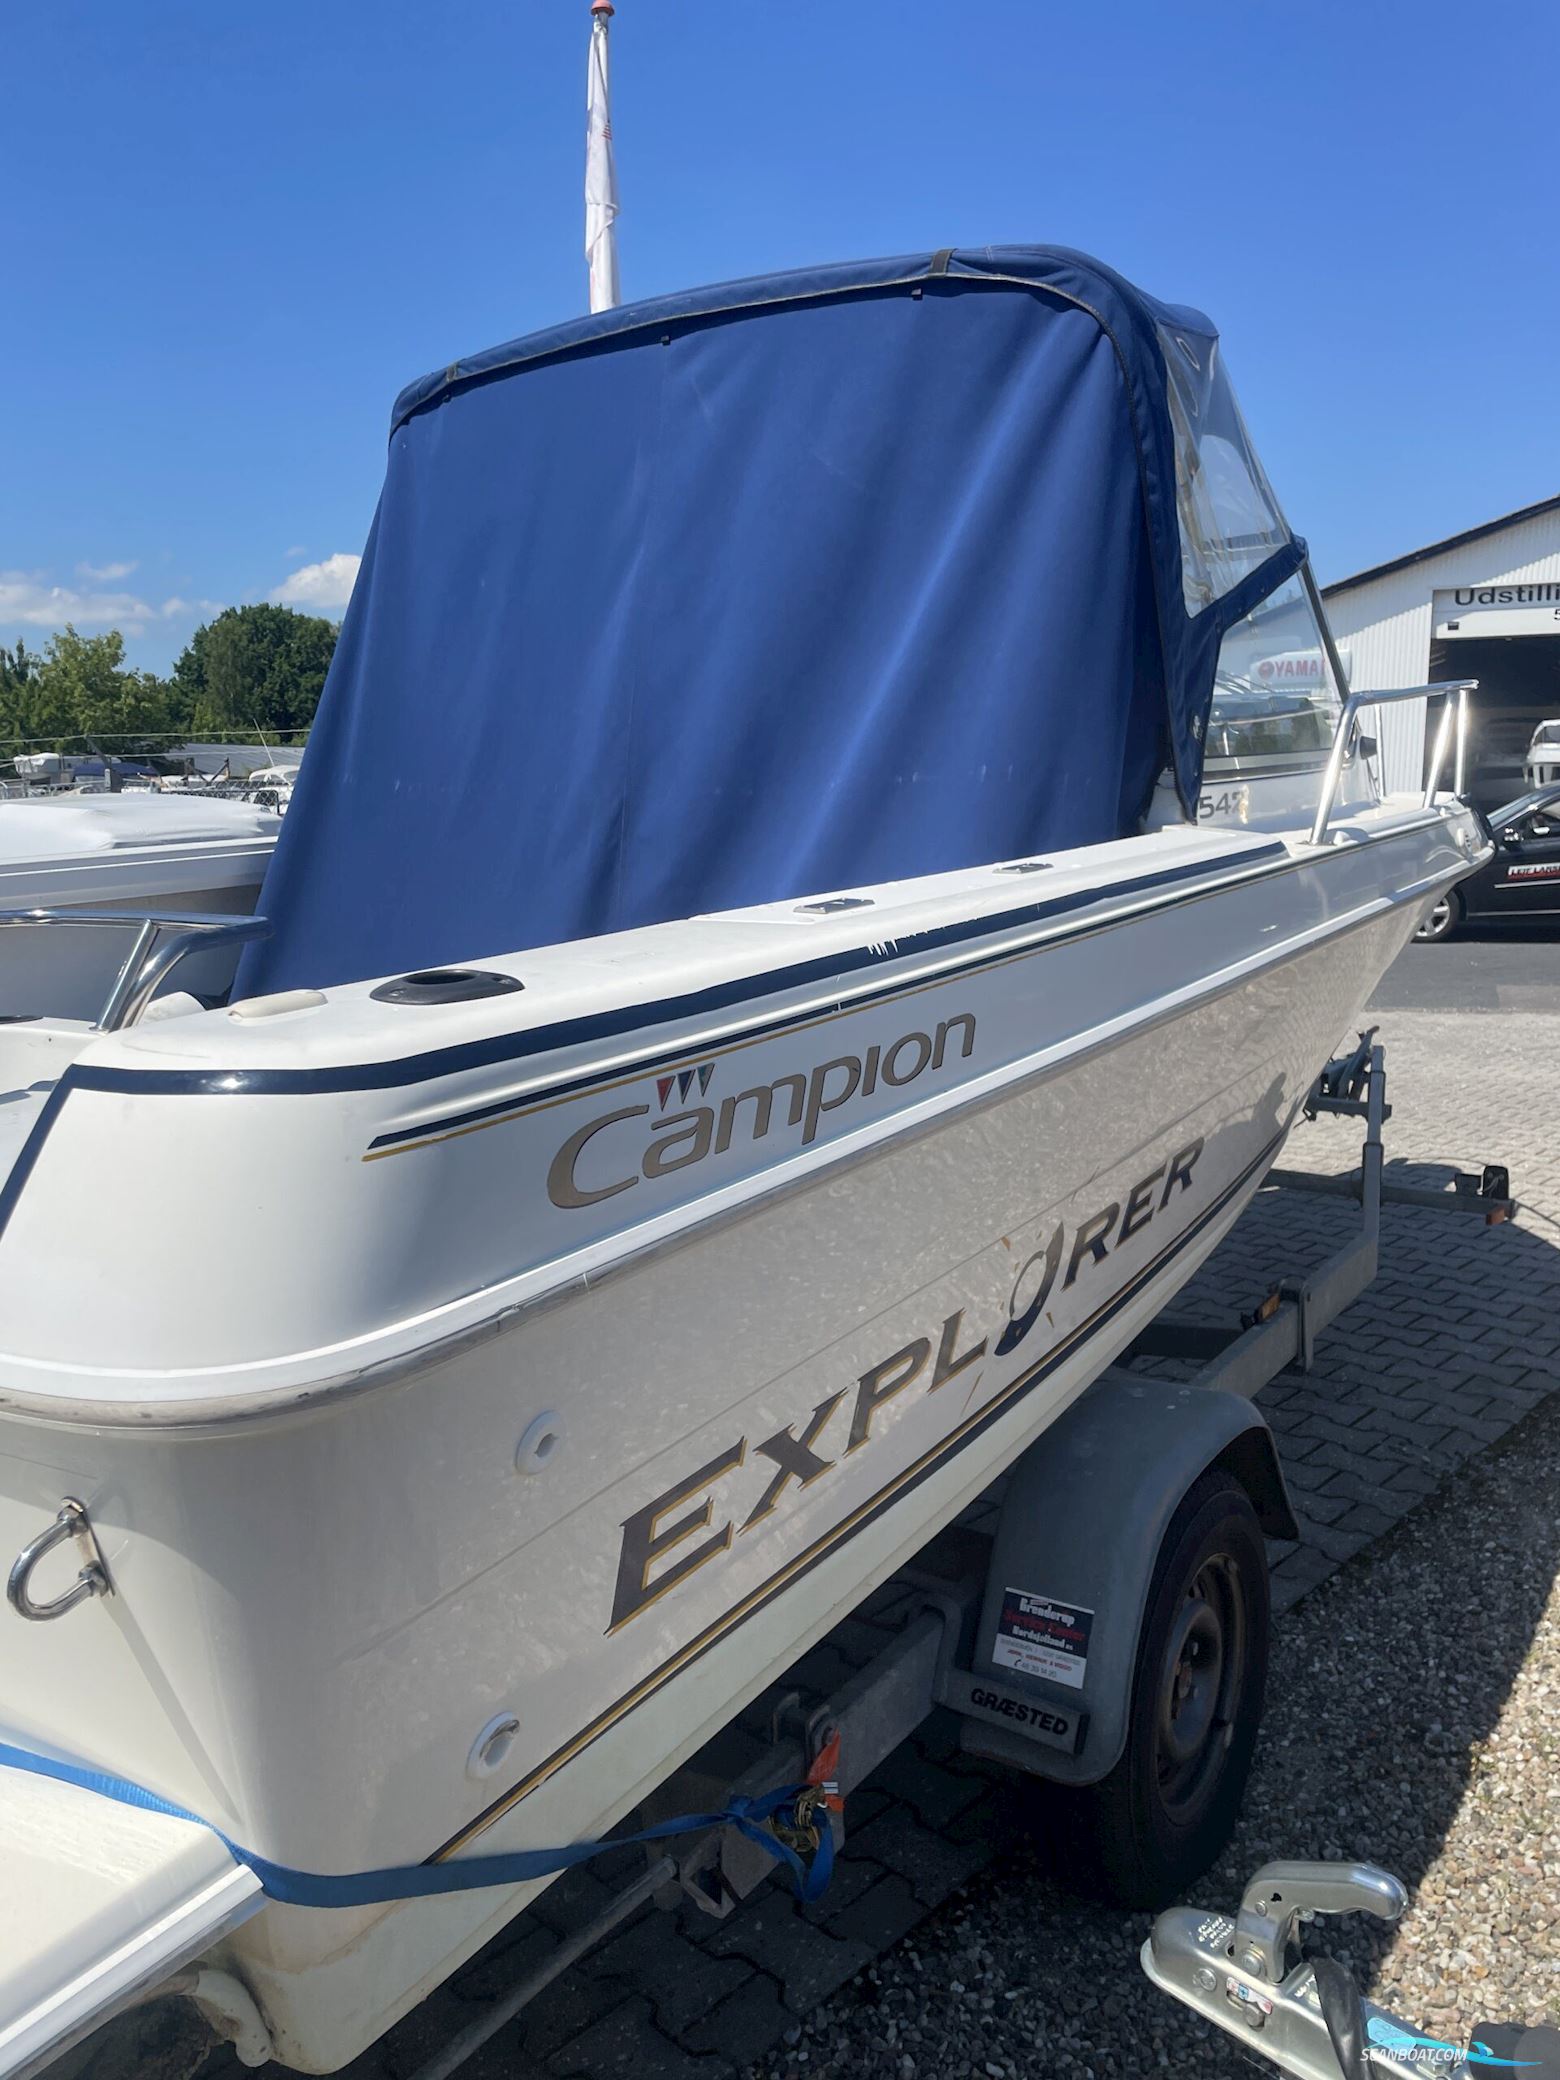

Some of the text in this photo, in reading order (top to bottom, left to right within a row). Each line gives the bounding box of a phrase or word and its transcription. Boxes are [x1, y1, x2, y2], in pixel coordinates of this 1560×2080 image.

[547, 1012, 977, 1208] Campion
[603, 1136, 1205, 1637] EXPLORER
[1019, 1597, 1075, 1627] Brenderup
[970, 1687, 1069, 1736] GRÆSTED
